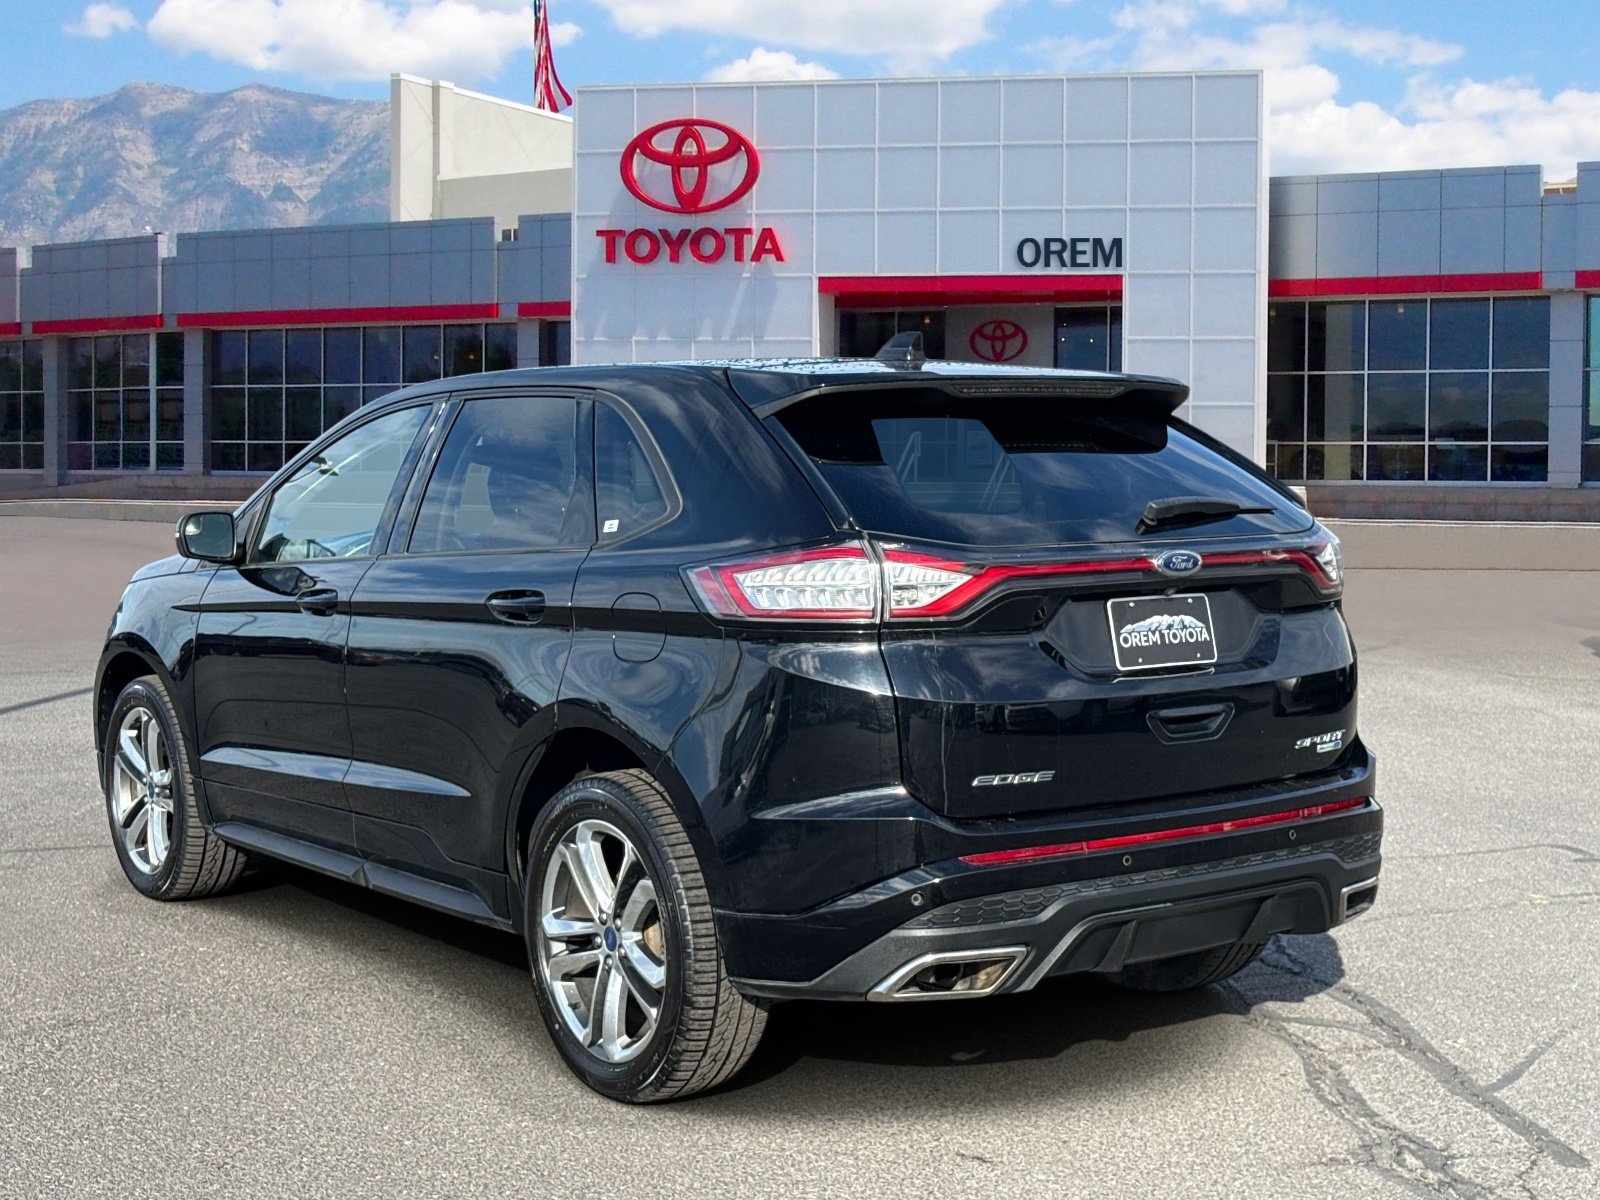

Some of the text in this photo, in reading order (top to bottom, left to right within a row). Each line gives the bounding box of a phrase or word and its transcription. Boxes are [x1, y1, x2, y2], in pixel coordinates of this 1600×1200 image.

[596, 227, 785, 264] TOYOTA
[1017, 237, 1123, 268] OREM
[1169, 555, 1194, 570] Ford
[1120, 627, 1210, 648] OREM TOYOTA
[1294, 729, 1346, 749] SPORT
[972, 771, 1055, 786] EDGE
